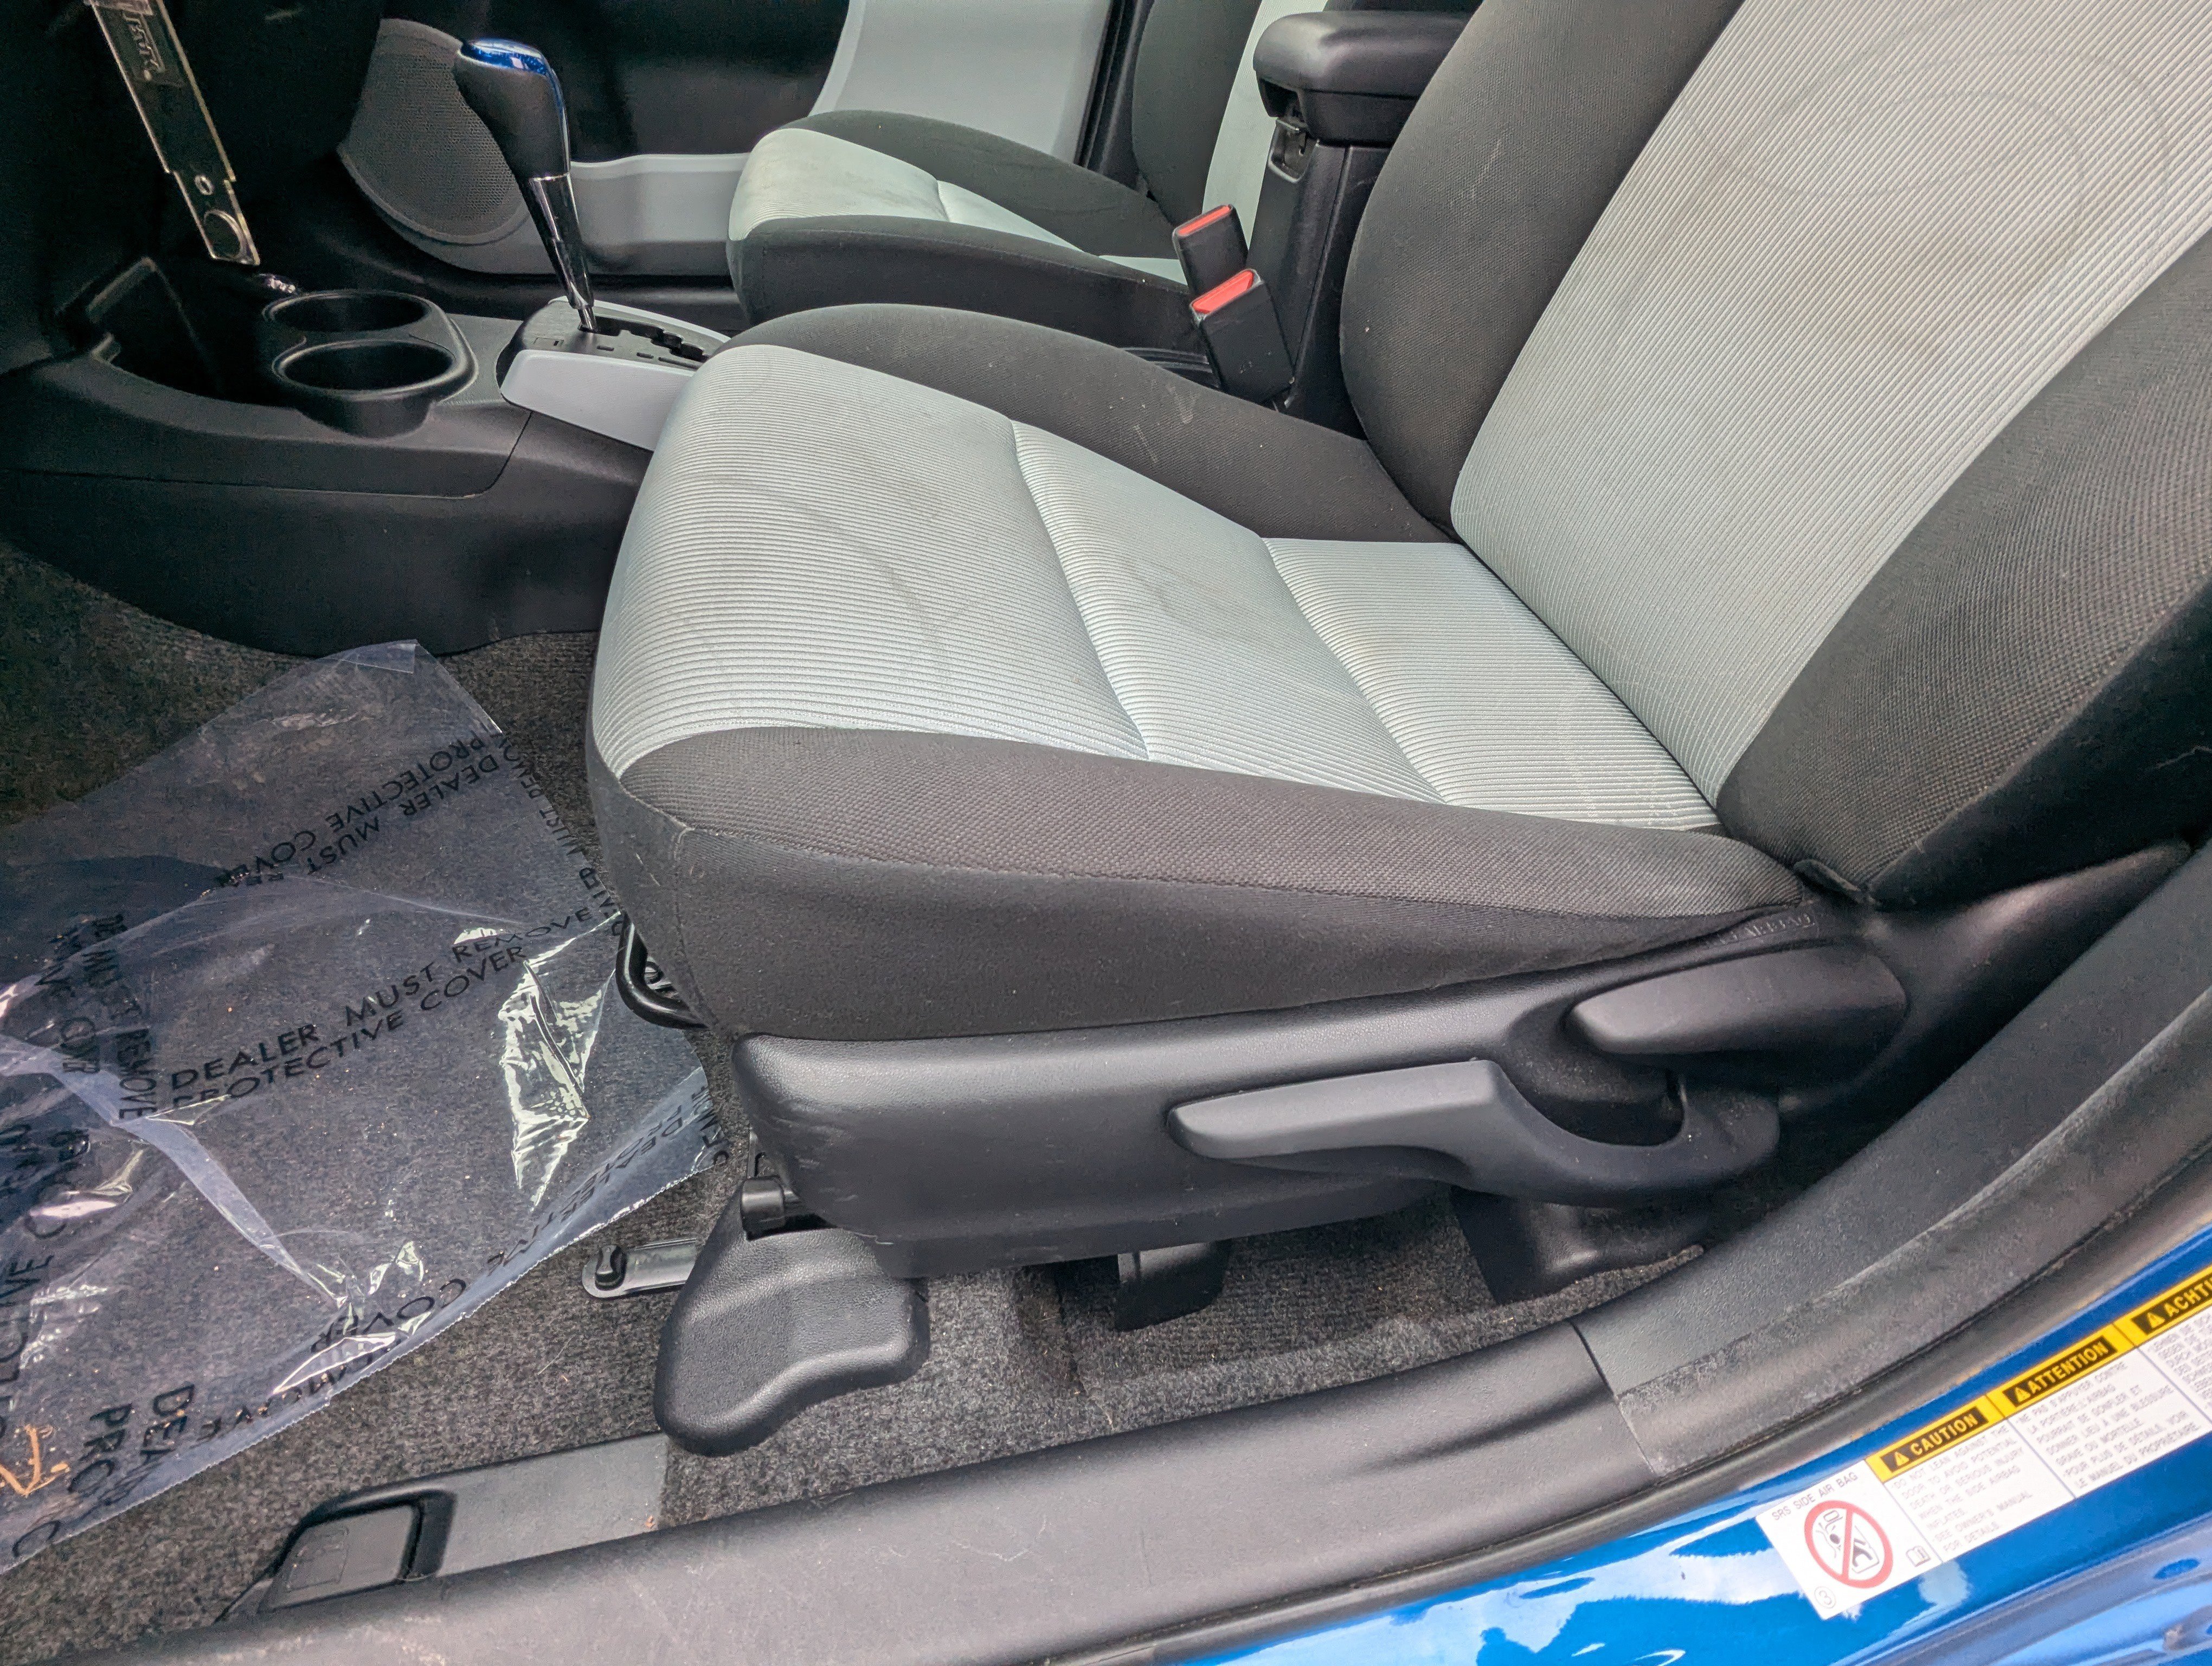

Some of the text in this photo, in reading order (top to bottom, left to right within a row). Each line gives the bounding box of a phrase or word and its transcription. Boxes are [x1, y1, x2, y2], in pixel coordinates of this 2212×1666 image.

[325, 730, 485, 833] PROTECTIVE
[307, 754, 499, 875] DEALER MUST
[171, 1023, 321, 1090] DEALER
[345, 962, 434, 1027] MUST
[451, 906, 591, 963] REMOVE
[420, 945, 526, 1011] COVER
[2027, 1341, 2109, 1394] ATTENTION
[1893, 1477, 1908, 1489] DO
[1908, 1468, 1927, 1481] NOT
[1928, 1455, 1952, 1471] LEAN
[1990, 1425, 2010, 1439] THE
[1910, 1413, 1979, 1456] CAUTION
[1771, 1472, 1859, 1521] SRS SIDE AIR BAG
[1901, 1436, 2018, 1499] DOOR TO AVOID POTENTIAL
[1938, 1483, 1953, 1495] OR
[1944, 1493, 1964, 1507] THE
[1818, 1590, 1833, 1606] 3
